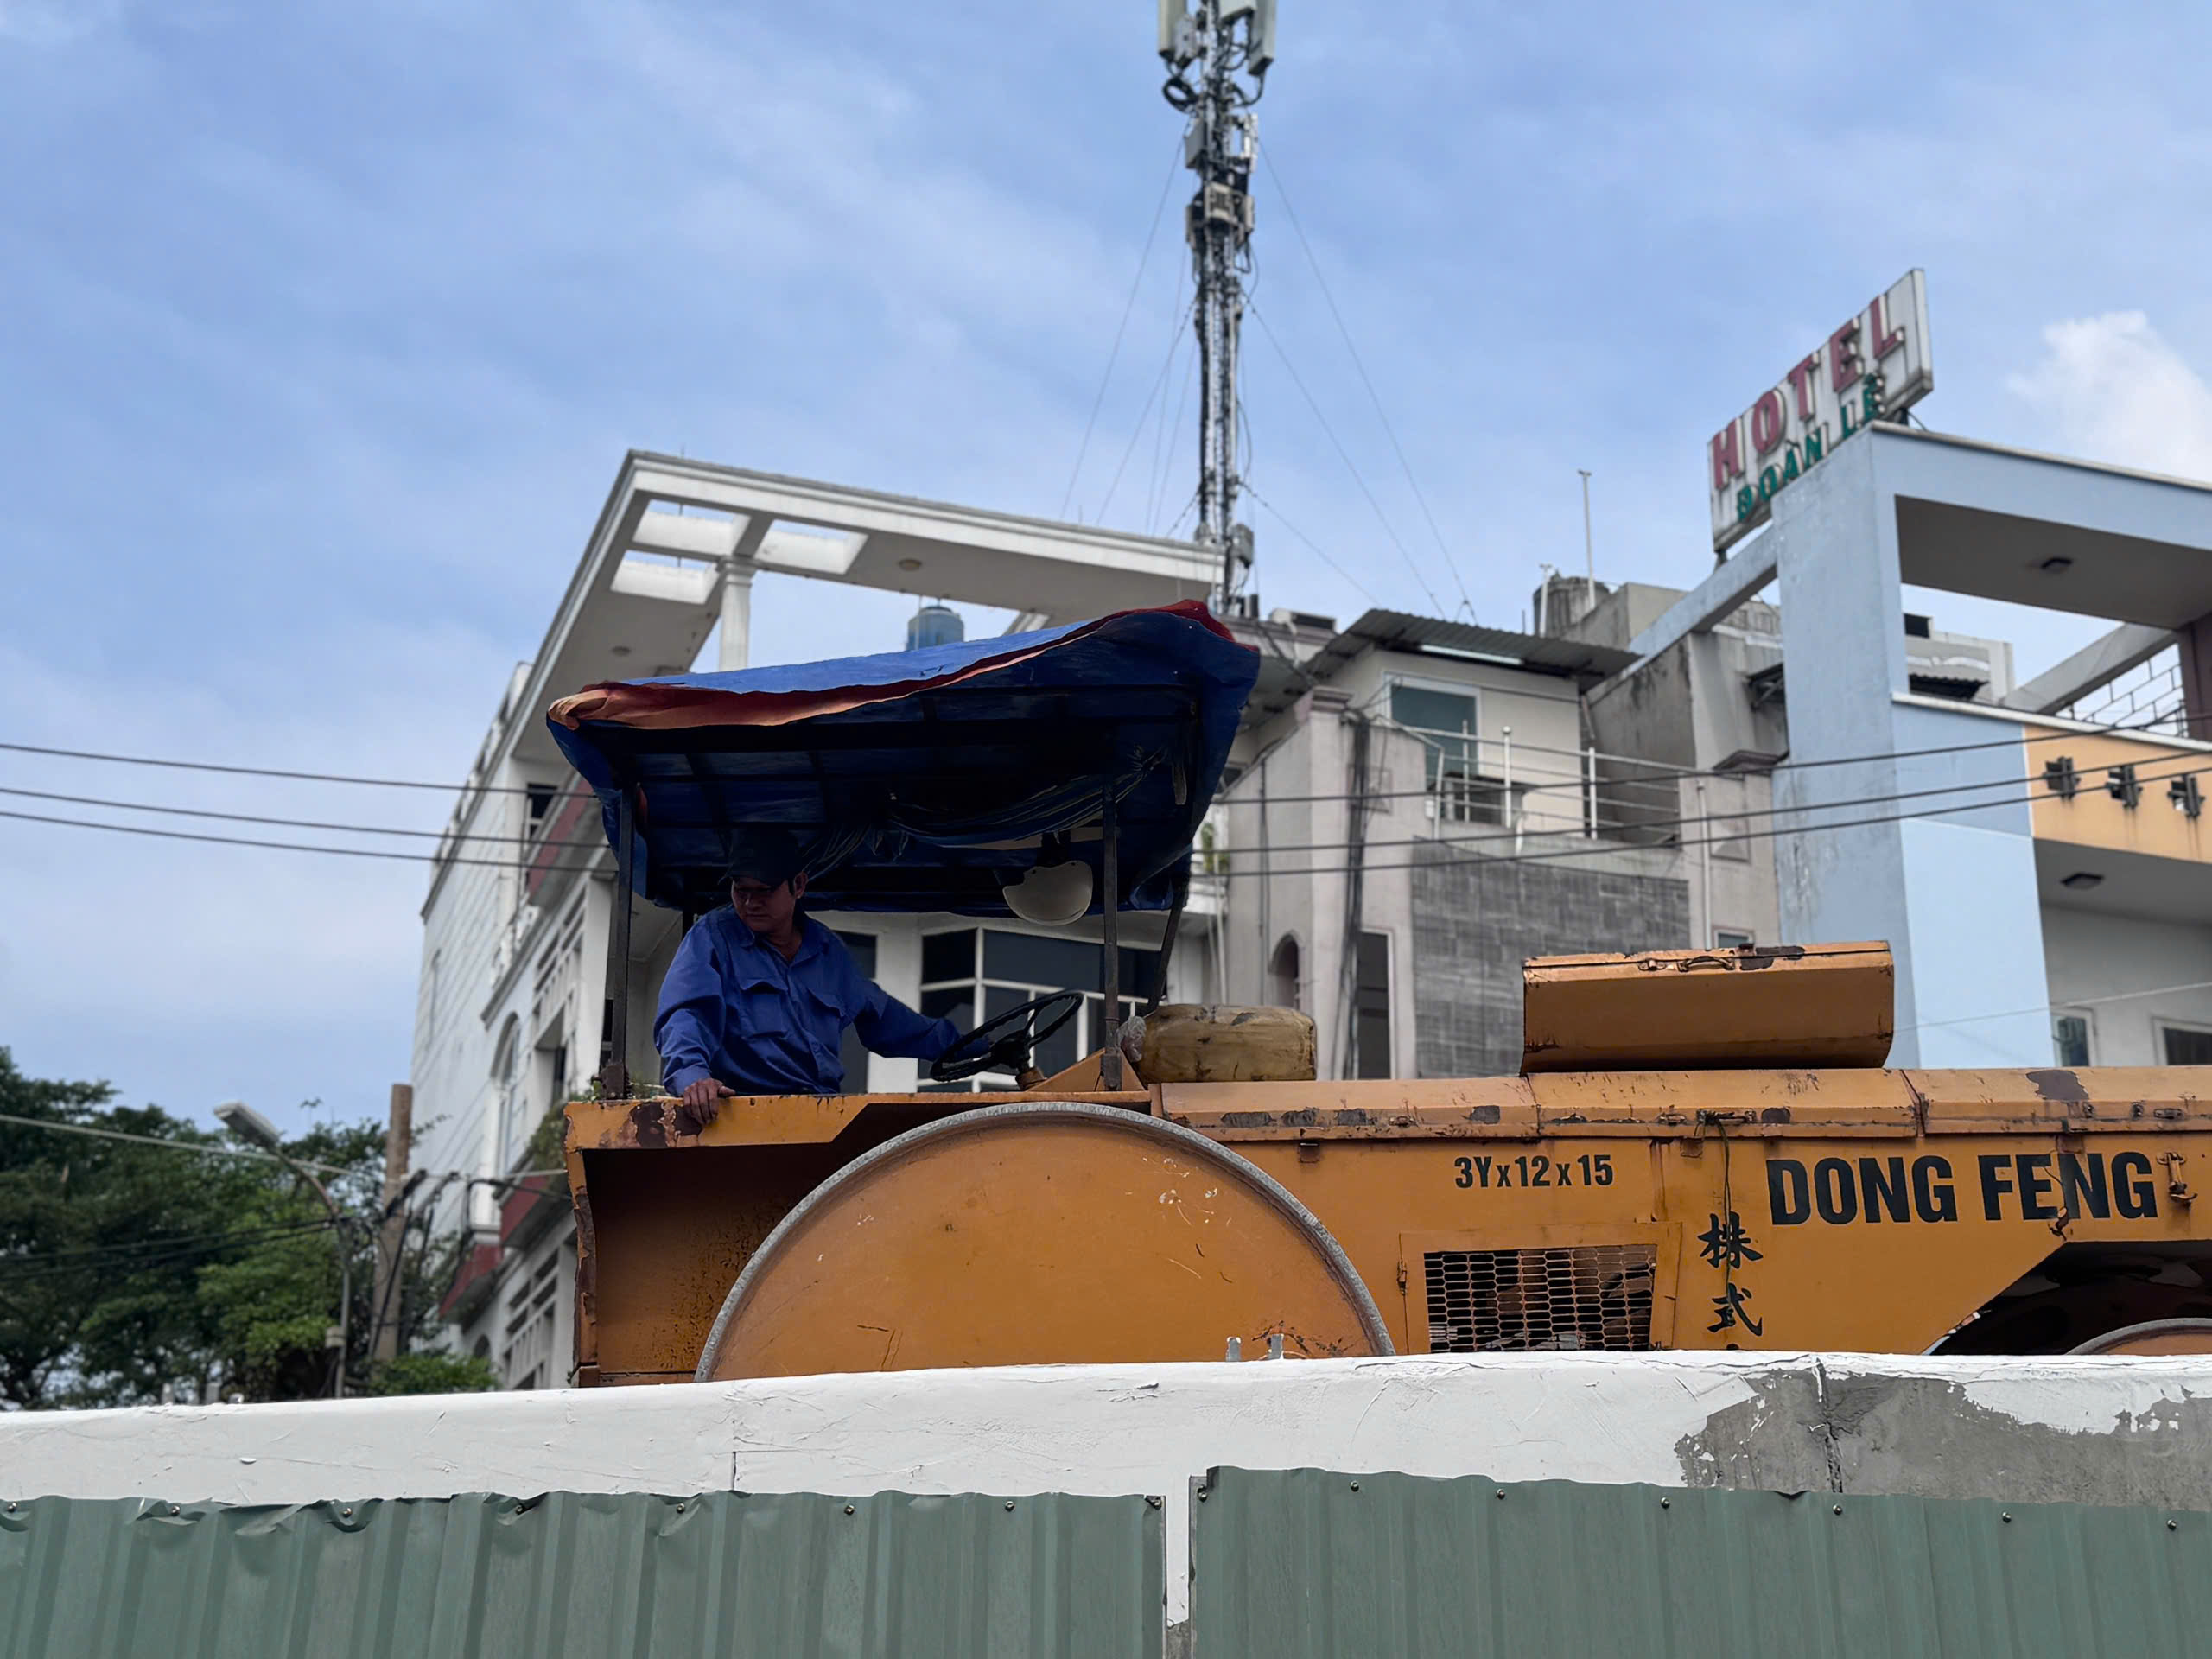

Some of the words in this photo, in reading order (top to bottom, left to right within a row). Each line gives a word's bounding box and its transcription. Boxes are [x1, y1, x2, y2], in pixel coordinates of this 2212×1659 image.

[1712, 295, 1905, 490] HOTEL
[1765, 1155, 1958, 1225] DONG
[1977, 1151, 2158, 1221] FENG
[1697, 1211, 1764, 1351] 株式
